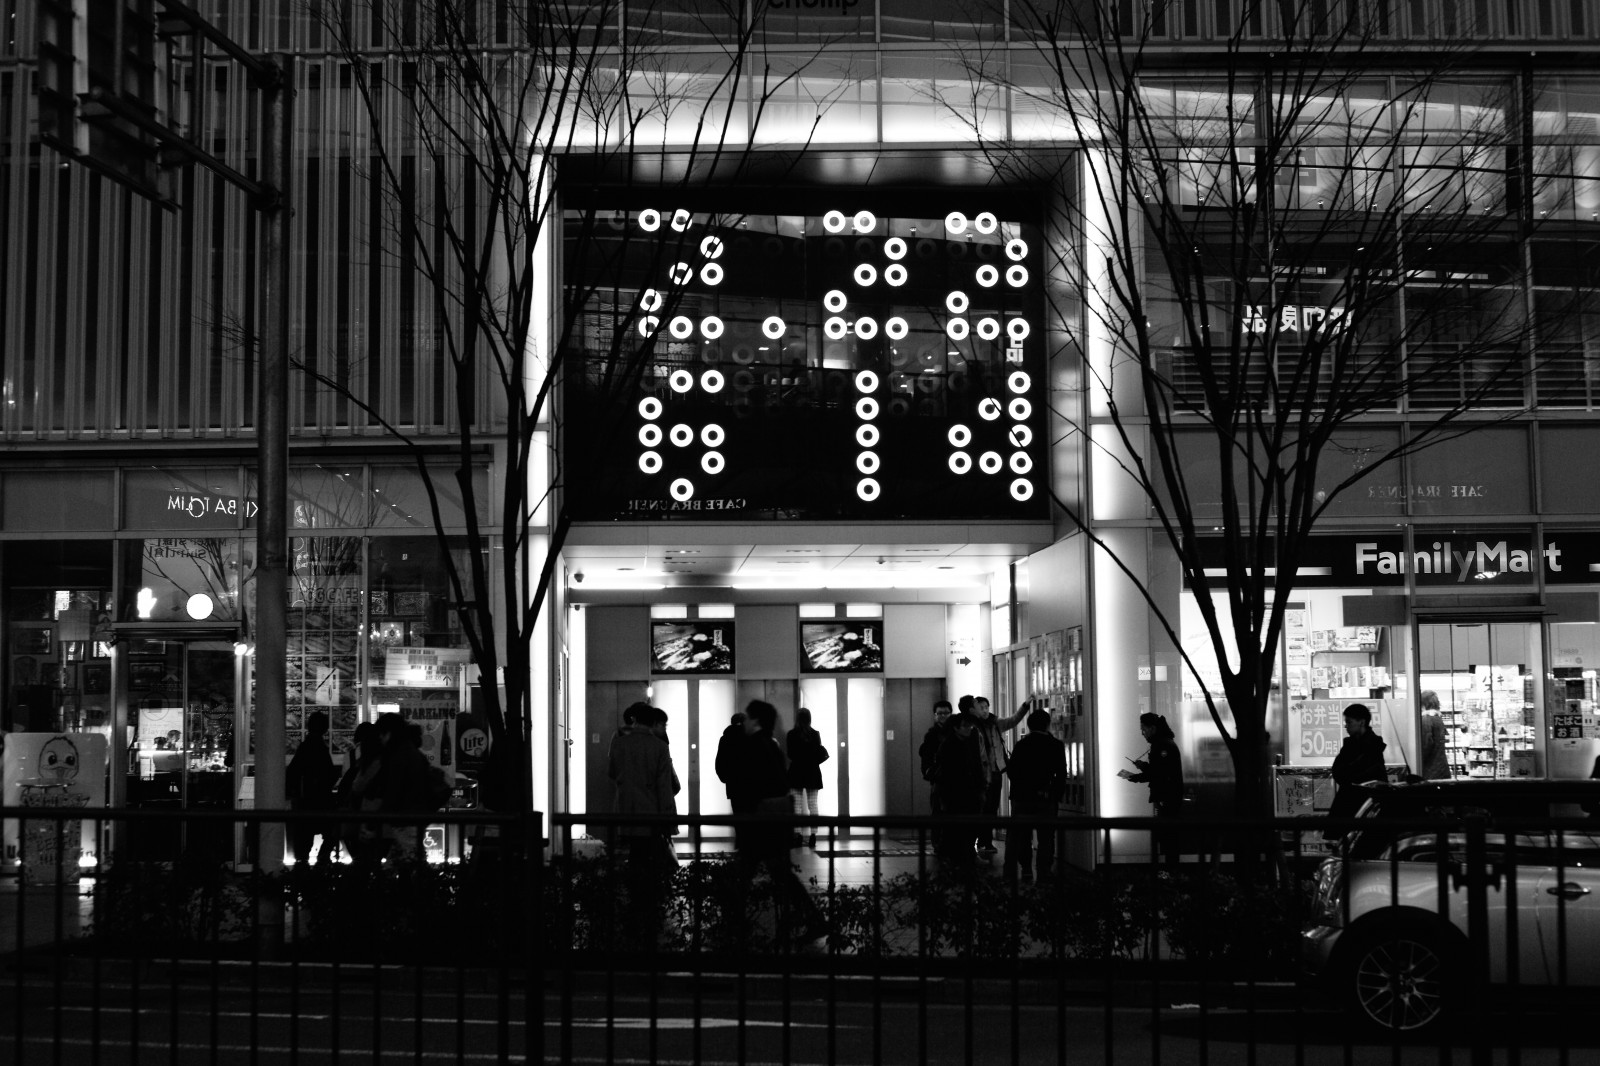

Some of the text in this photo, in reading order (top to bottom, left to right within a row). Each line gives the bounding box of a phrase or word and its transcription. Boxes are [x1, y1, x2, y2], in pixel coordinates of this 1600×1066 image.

[326, 587, 359, 604] CAFE
[1301, 702, 1381, 726] お弁当品
[1554, 716, 1582, 727] たばこ
